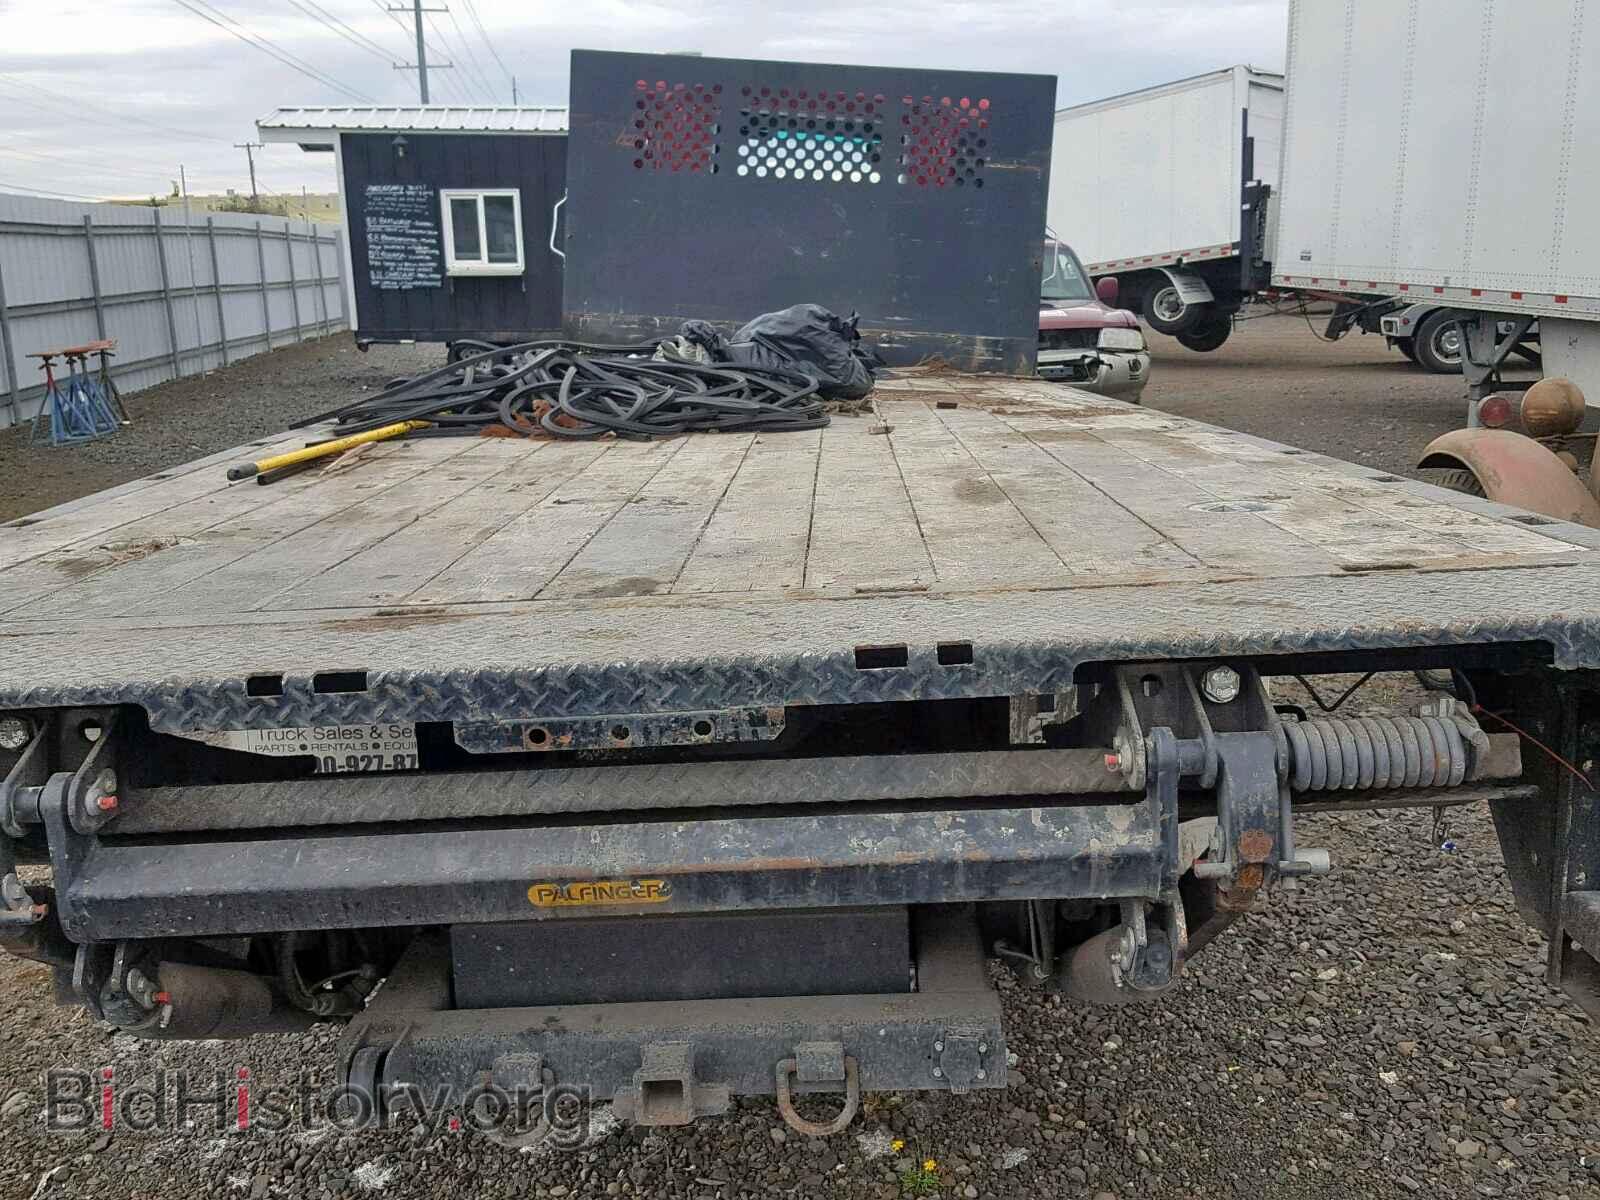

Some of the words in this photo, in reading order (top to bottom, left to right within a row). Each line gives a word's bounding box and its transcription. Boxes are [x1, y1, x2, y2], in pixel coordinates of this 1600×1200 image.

[260, 727, 307, 741] Truck
[313, 725, 364, 740] Sales
[369, 725, 382, 739] &
[389, 724, 417, 739] Se
[254, 743, 297, 753] PARTS
[311, 742, 369, 751] RENTALS
[537, 884, 665, 902] PALFINGER
